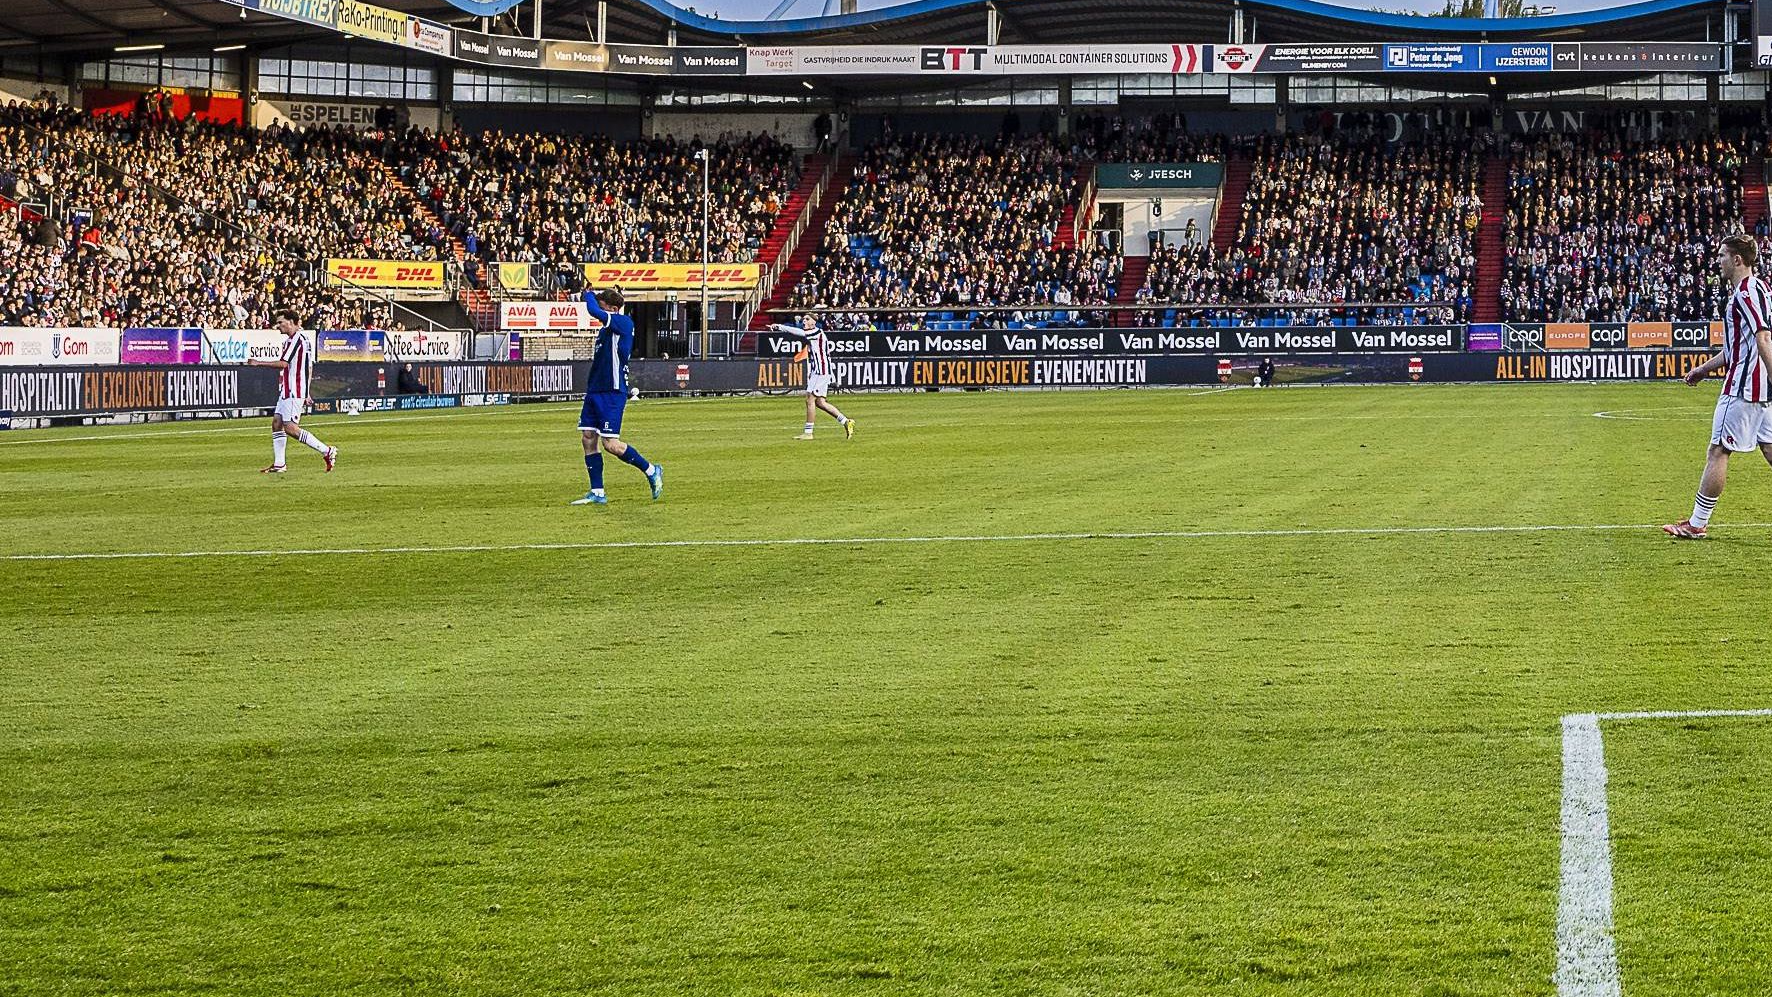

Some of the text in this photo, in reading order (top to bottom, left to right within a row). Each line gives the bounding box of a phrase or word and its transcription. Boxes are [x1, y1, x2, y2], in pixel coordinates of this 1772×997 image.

[337, 0, 407, 39] RaKo-Printing.nl
[460, 40, 489, 54] Van Mossel
[497, 46, 538, 59] Van Mossel
[749, 48, 793, 58] Knap Werk
[1274, 47, 1309, 55] ENERGIE
[1310, 47, 1333, 55] VOOR
[1334, 47, 1349, 55] ELK
[1511, 47, 1548, 57] GEWOON
[554, 50, 604, 63] Van Mossel
[618, 54, 673, 66] Van Mossel
[683, 56, 739, 67] Van Mossel
[765, 59, 793, 68] Target
[803, 56, 916, 65] GASTVRIJHEID DIE INDRUK MAAKT
[920, 47, 987, 71] BTT
[994, 52, 1168, 65] MULTIMODAL CONTAINER SOLUTIONS
[1409, 53, 1463, 64] Peter de Jong
[1495, 57, 1548, 67] IJZERSTERK!
[1556, 52, 1576, 62] cvt
[1583, 54, 1636, 62] keukens
[1652, 54, 1715, 62] interieur
[289, 104, 376, 124] DE SPELEN
[337, 265, 379, 280] DHL
[396, 267, 436, 281] DHL
[598, 268, 660, 282] DHL
[686, 269, 746, 282] DHL
[1003, 333, 1104, 350] Van Mossel
[1120, 332, 1220, 350] Van Mossel
[1236, 331, 1336, 349] Van Mossel
[1352, 331, 1385, 347] Van
[1391, 330, 1452, 346] Mossel
[1509, 326, 1543, 346] capi
[1591, 325, 1626, 345] capi
[1673, 325, 1708, 345] capi
[64, 336, 88, 356] Gom
[251, 343, 280, 357] service
[769, 336, 870, 353] Van ossel
[886, 335, 987, 352] Van Mossel
[758, 359, 1147, 386] ALL-IN EN EXCLUSIEVE EVENEMENTEN
[1497, 354, 1676, 379] ALL-IN HOSPITALITY EN
[443, 365, 486, 394] HOSPITALITY
[532, 365, 573, 392] EVENEMENTEN
[2, 370, 238, 412] HOSPITALITY EN EXCLUSIEVE EVENEMENTEN
[314, 402, 331, 411] TILBURG
[401, 397, 415, 408] 100%
